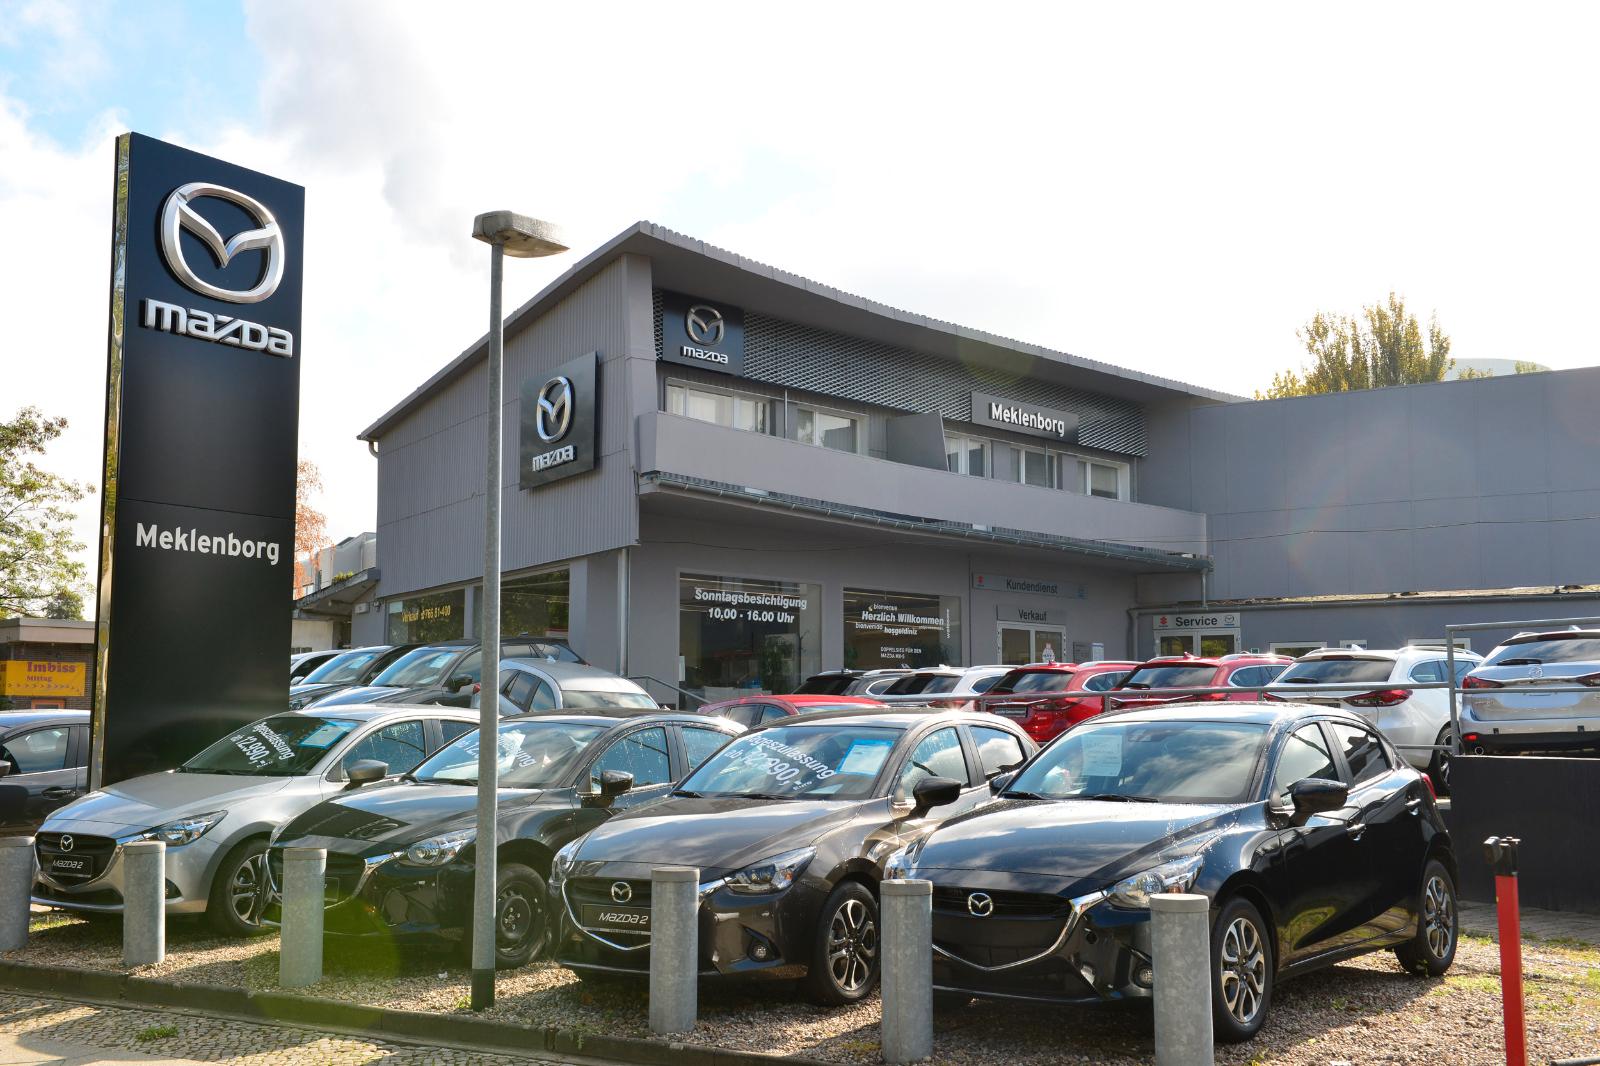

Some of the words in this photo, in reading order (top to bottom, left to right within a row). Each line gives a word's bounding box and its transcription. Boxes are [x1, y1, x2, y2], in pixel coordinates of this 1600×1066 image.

[991, 402, 1065, 437] Meklenborg
[136, 522, 280, 566] Meklenborg
[1006, 579, 1058, 594] Kundendienst
[694, 588, 808, 610] Sonntagsbesichtigung
[746, 610, 775, 622] 16.00
[777, 611, 795, 623] Uhr
[861, 610, 896, 622] Herzlich
[897, 613, 945, 625] Willkommen
[1018, 609, 1047, 621] Verkauf
[1175, 616, 1218, 627] Service
[26, 661, 76, 673] Imbiss
